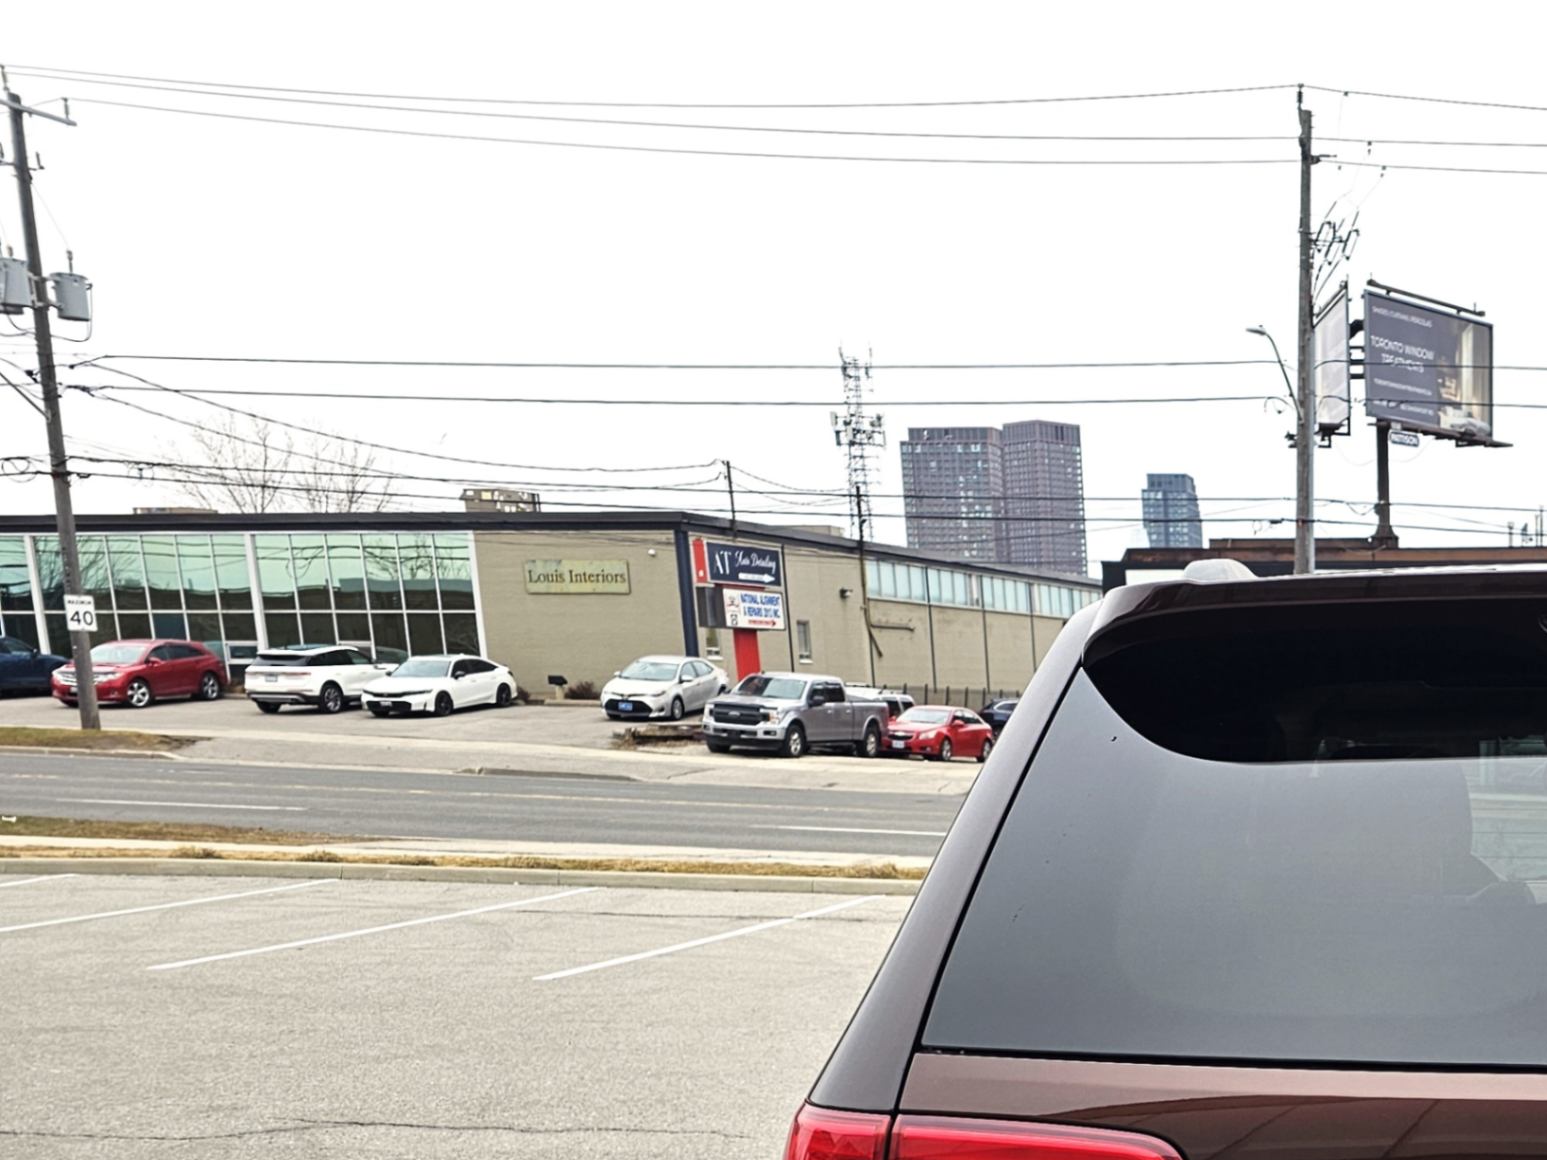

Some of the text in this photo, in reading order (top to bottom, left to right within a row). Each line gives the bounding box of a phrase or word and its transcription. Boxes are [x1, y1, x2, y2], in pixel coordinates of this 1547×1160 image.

[527, 568, 627, 584] Louis Interiors
[70, 610, 94, 626] 40
